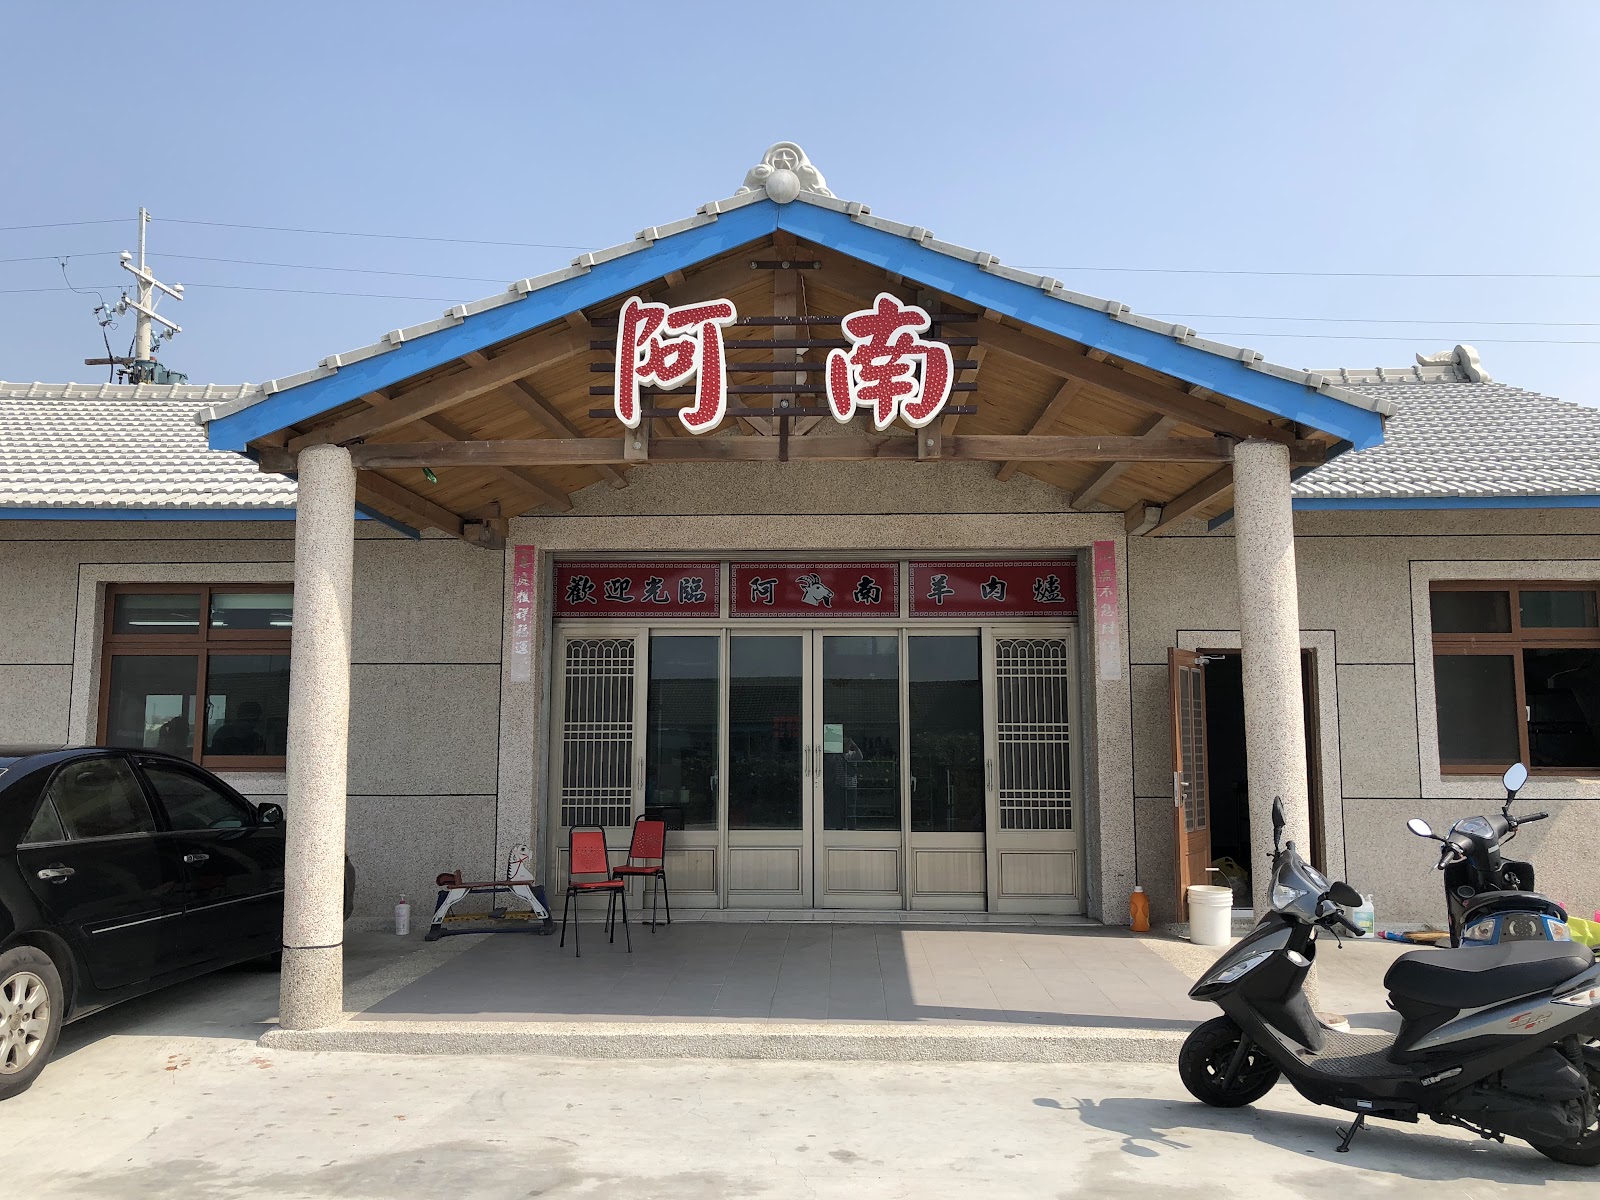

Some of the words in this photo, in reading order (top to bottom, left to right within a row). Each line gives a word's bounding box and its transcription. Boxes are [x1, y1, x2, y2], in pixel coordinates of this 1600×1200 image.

[614, 292, 955, 435] 阿南
[565, 575, 707, 605] 歡迎光臨
[748, 575, 882, 606] 阿南
[926, 573, 1066, 605] 羊肉爐
